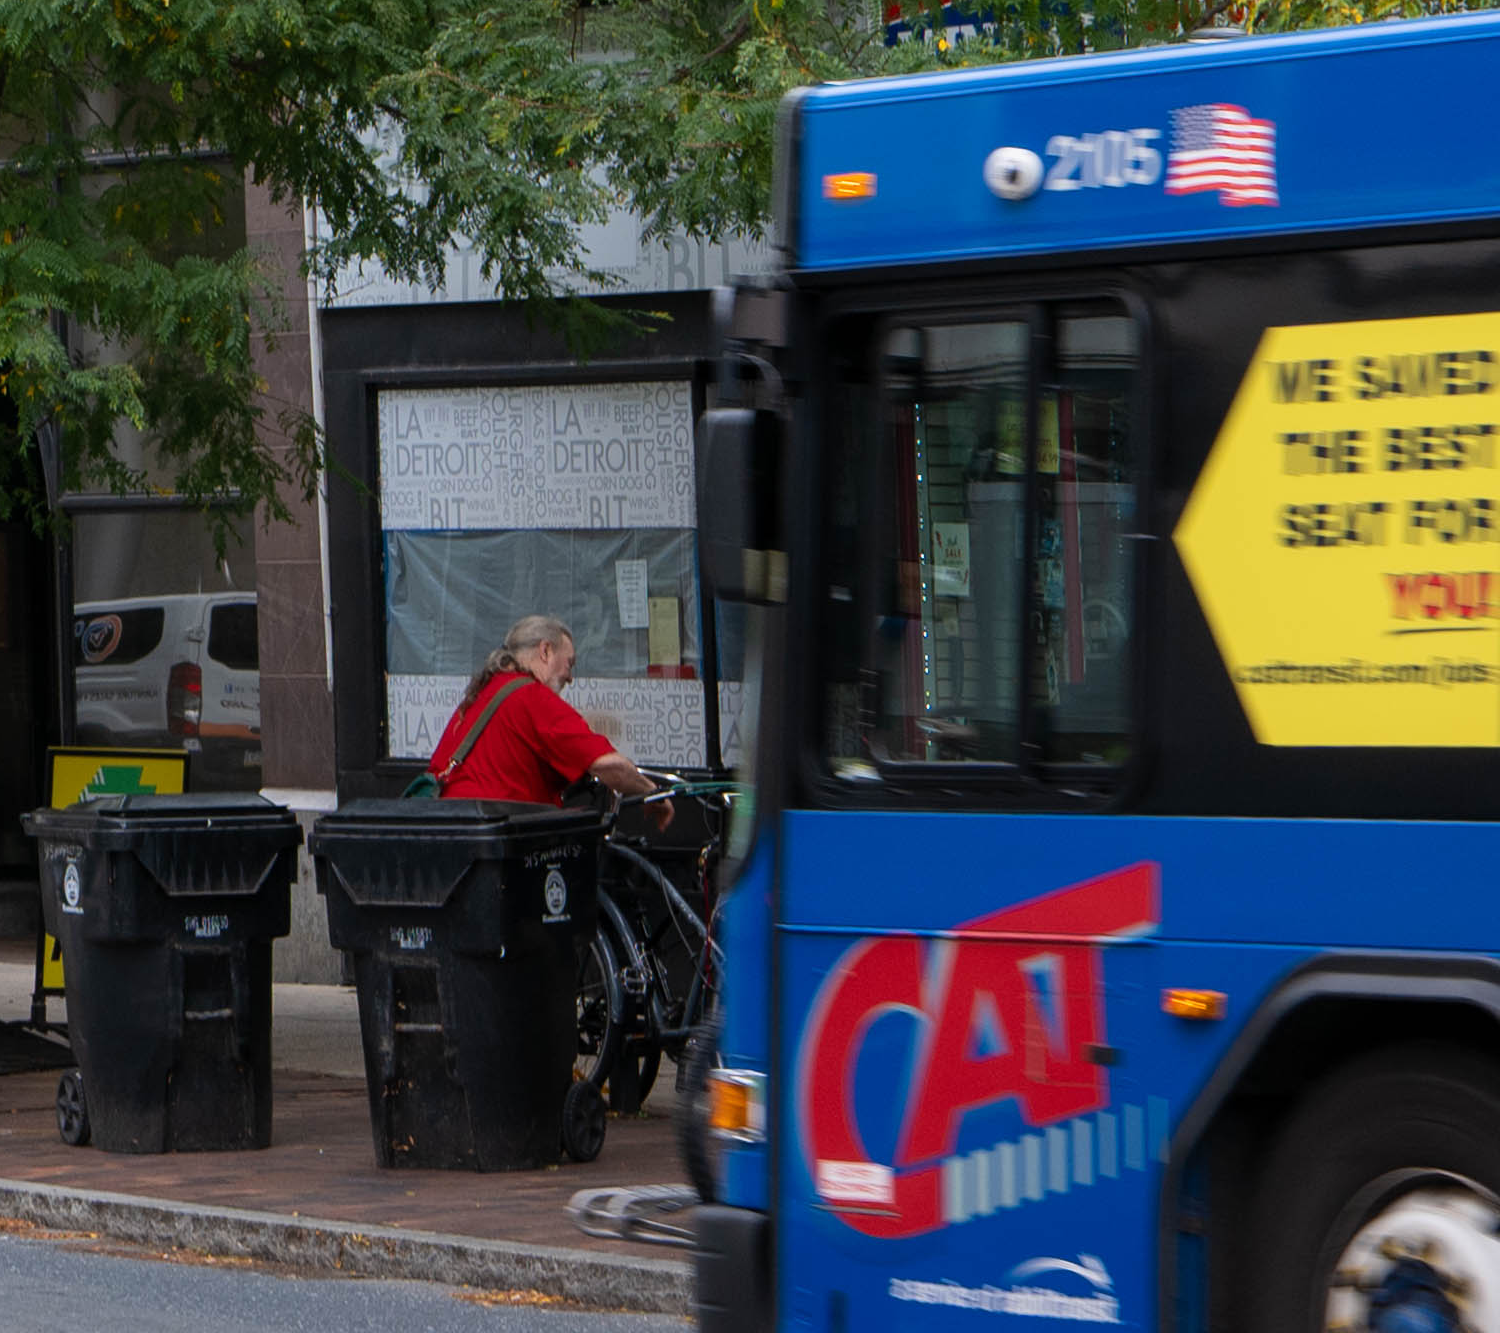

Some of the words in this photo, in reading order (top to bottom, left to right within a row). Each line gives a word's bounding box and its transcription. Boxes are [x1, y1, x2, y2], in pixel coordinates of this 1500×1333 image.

[1044, 128, 1162, 191] 2105
[1268, 358, 1340, 403] WE
[396, 405, 422, 439] LA
[454, 409, 478, 428] BEEF
[553, 399, 582, 435] LA
[614, 404, 641, 423] BEEF
[508, 389, 526, 498] URGERS
[554, 439, 643, 474] DETROIT
[673, 384, 692, 497] URGERS
[1277, 430, 1368, 476] THE
[1380, 424, 1498, 472] BEST
[396, 443, 481, 476] DETROIT
[458, 478, 481, 493] DOG
[619, 476, 643, 491] DOG
[1277, 501, 1392, 547] SEAT
[586, 693, 652, 710] AMERICAN
[404, 711, 433, 746] LA
[668, 694, 684, 764] POLIS
